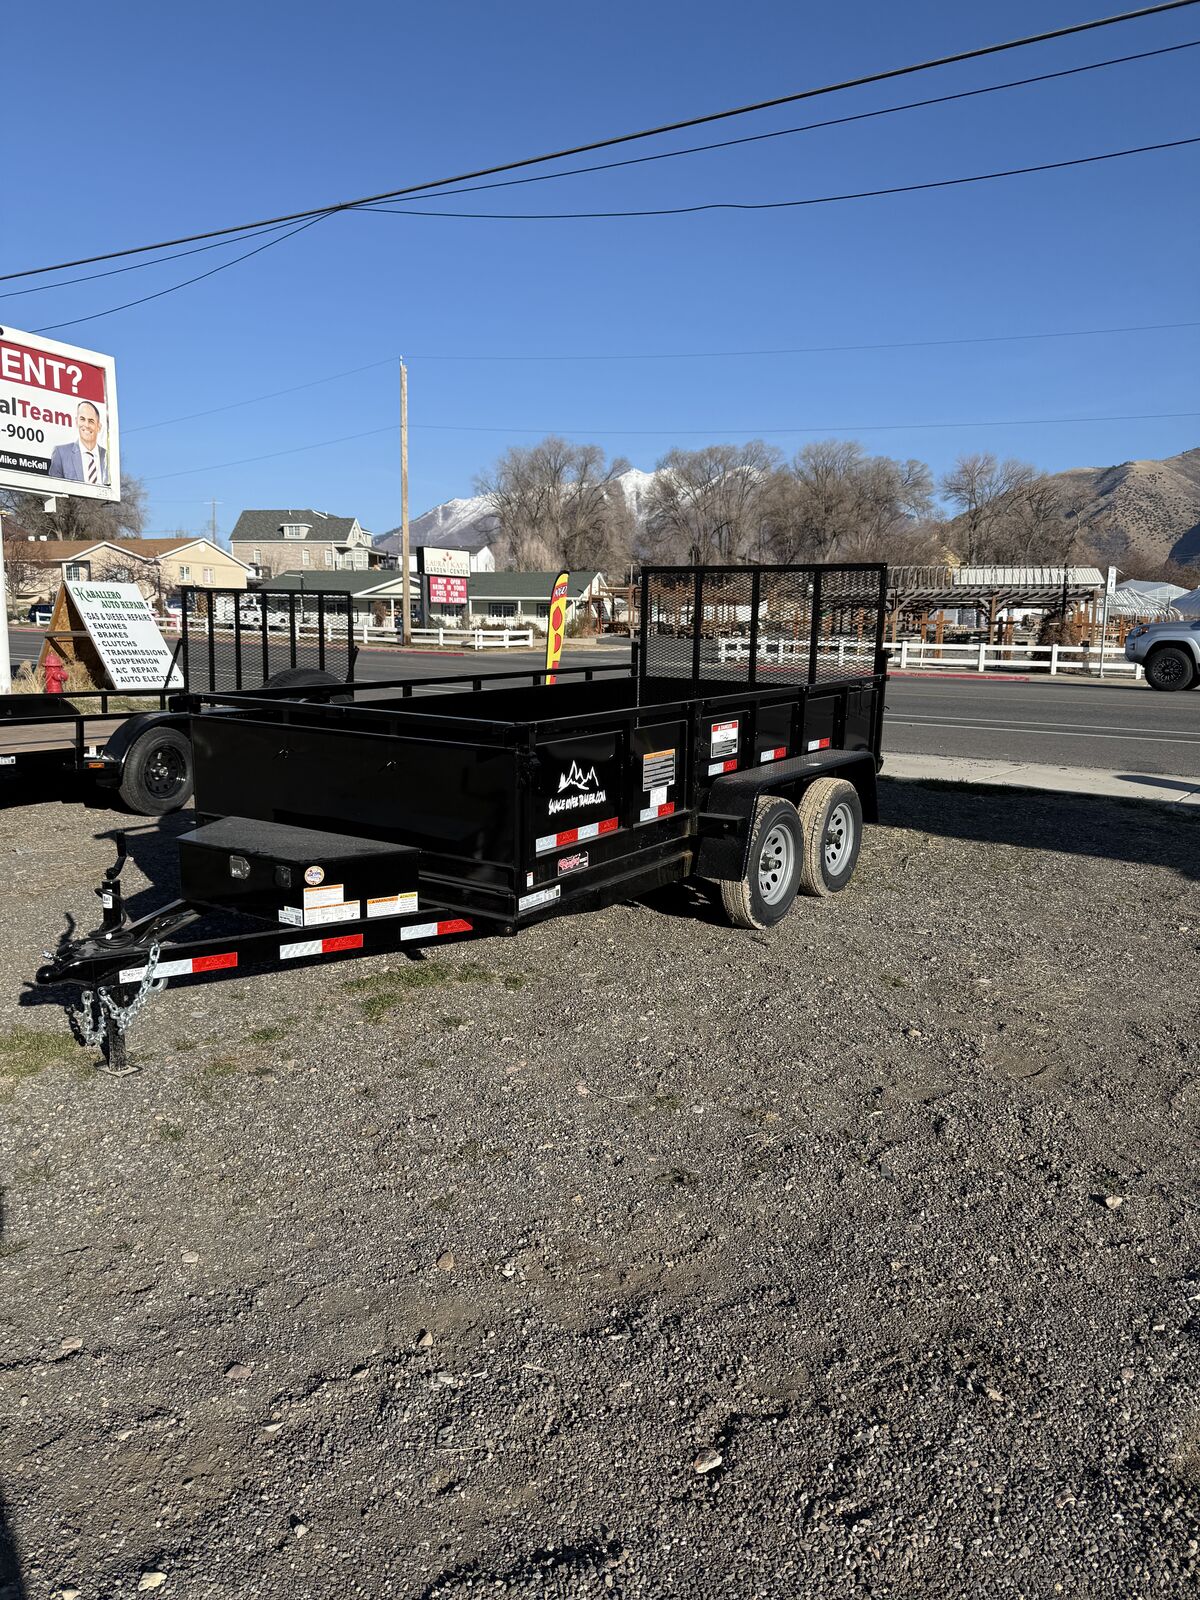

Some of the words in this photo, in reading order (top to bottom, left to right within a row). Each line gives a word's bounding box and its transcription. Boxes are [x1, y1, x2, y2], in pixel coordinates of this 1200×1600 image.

[1, 347, 83, 394] ENT?
[0, 397, 72, 427] alTeam
[0, 423, 45, 443] -9000
[0, 454, 17, 465] Mike
[19, 458, 48, 471] McKell
[72, 587, 121, 602] KABALLERO
[101, 601, 121, 609] AUTO
[122, 602, 146, 610] REPAIR
[106, 612, 127, 621] DIESEL
[128, 612, 152, 621] REPAIRS
